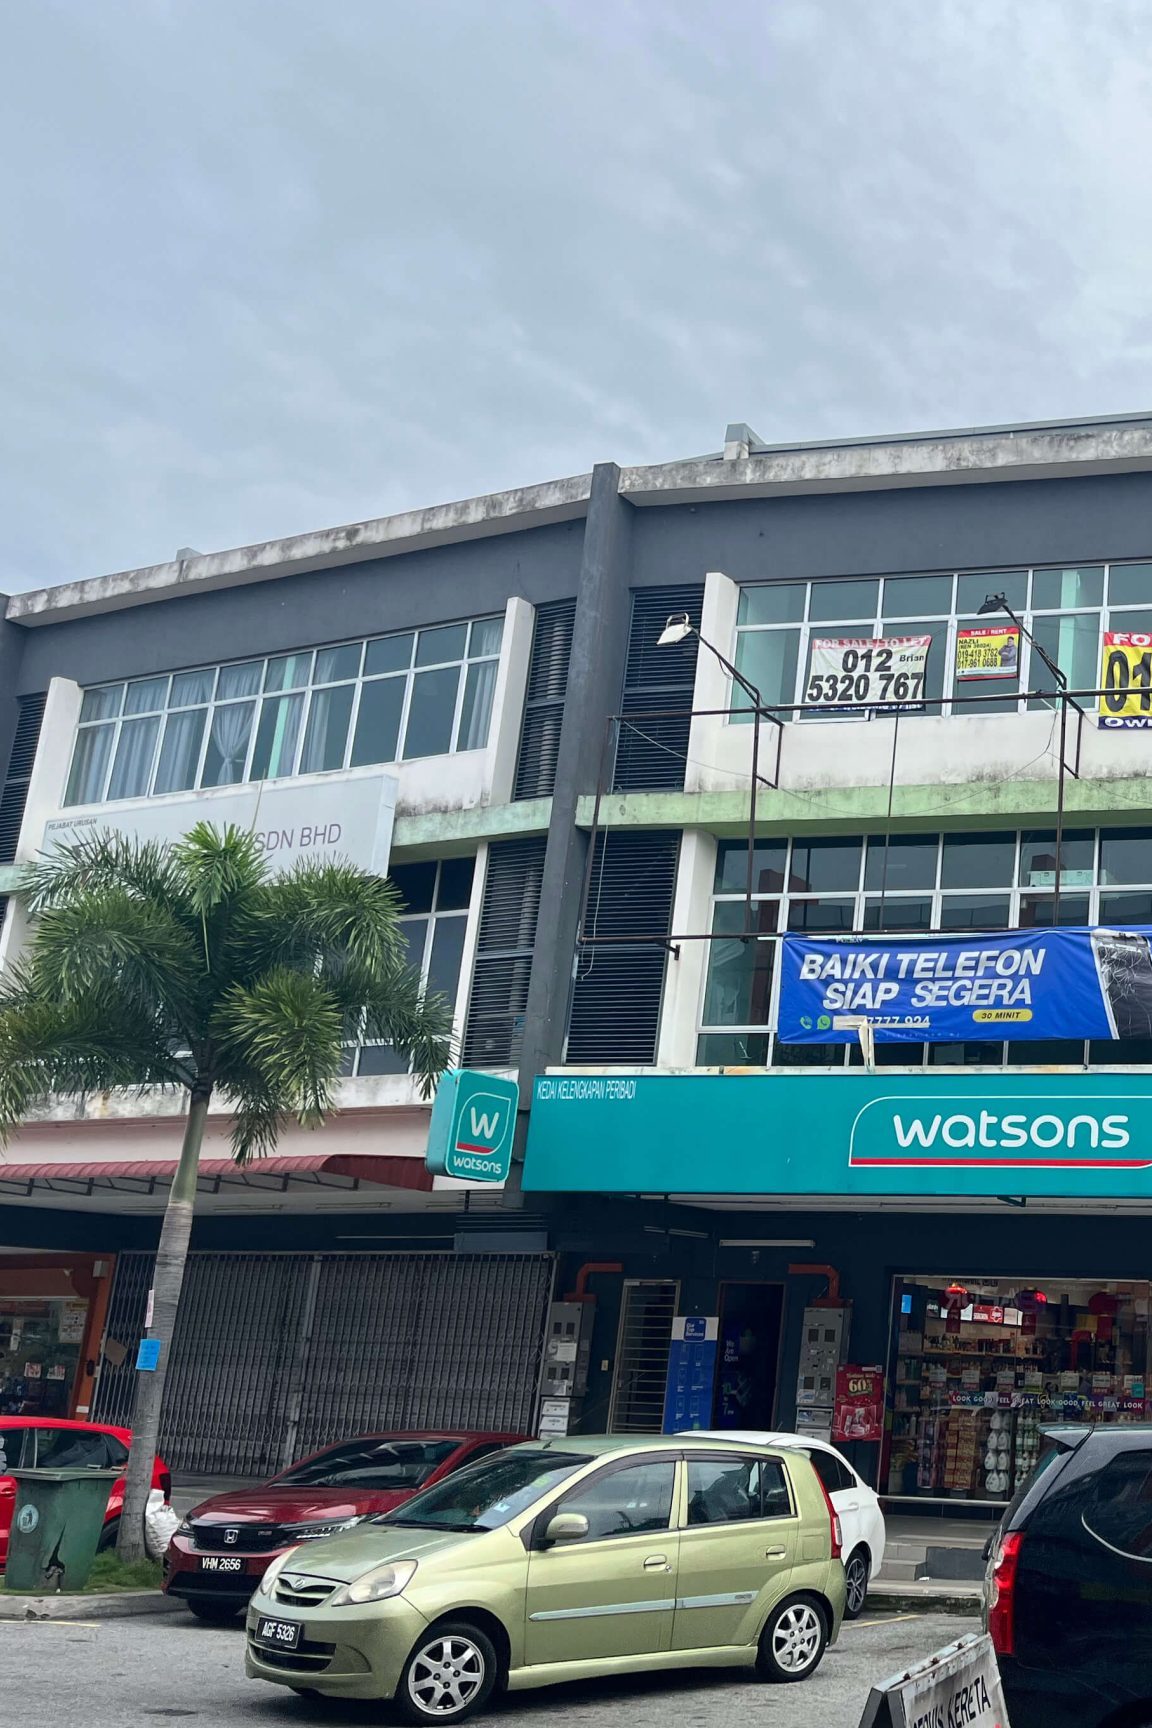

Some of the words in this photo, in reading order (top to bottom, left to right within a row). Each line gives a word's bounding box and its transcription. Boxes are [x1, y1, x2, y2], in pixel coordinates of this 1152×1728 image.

[815, 640, 841, 649] FOR
[843, 639, 874, 648] SALE
[882, 639, 900, 647] TO
[903, 637, 927, 646] LET
[842, 649, 893, 673] 012
[900, 654, 924, 662] Brian
[807, 674, 870, 702] 5320
[879, 672, 924, 701] 767
[254, 829, 294, 852] SDN
[299, 823, 342, 847] BHD
[800, 953, 889, 980] BAIKI
[896, 949, 1047, 979] TELEFON
[822, 982, 900, 1010] SIAP
[911, 978, 1032, 1008] SEGERA
[981, 1012, 992, 1020] 30
[995, 1011, 1021, 1020] MINIT
[537, 1080, 557, 1100] KEDAI
[557, 1080, 606, 1100] KELENGKAPAN
[605, 1080, 637, 1100] PERIBADI
[893, 1110, 1130, 1149] watsons
[453, 1155, 502, 1174] watsons
[952, 1394, 970, 1402] LOOK
[1036, 1398, 1055, 1406] LOOK
[1081, 1400, 1096, 1408] FEEL
[1098, 1400, 1120, 1409] GREAT
[1123, 1401, 1143, 1409] LOOK
[202, 1557, 217, 1569] VHM
[219, 1558, 241, 1570] 2656
[262, 1621, 276, 1638] AGF
[276, 1621, 295, 1641] 5326
[947, 1675, 991, 1728] KERETA
